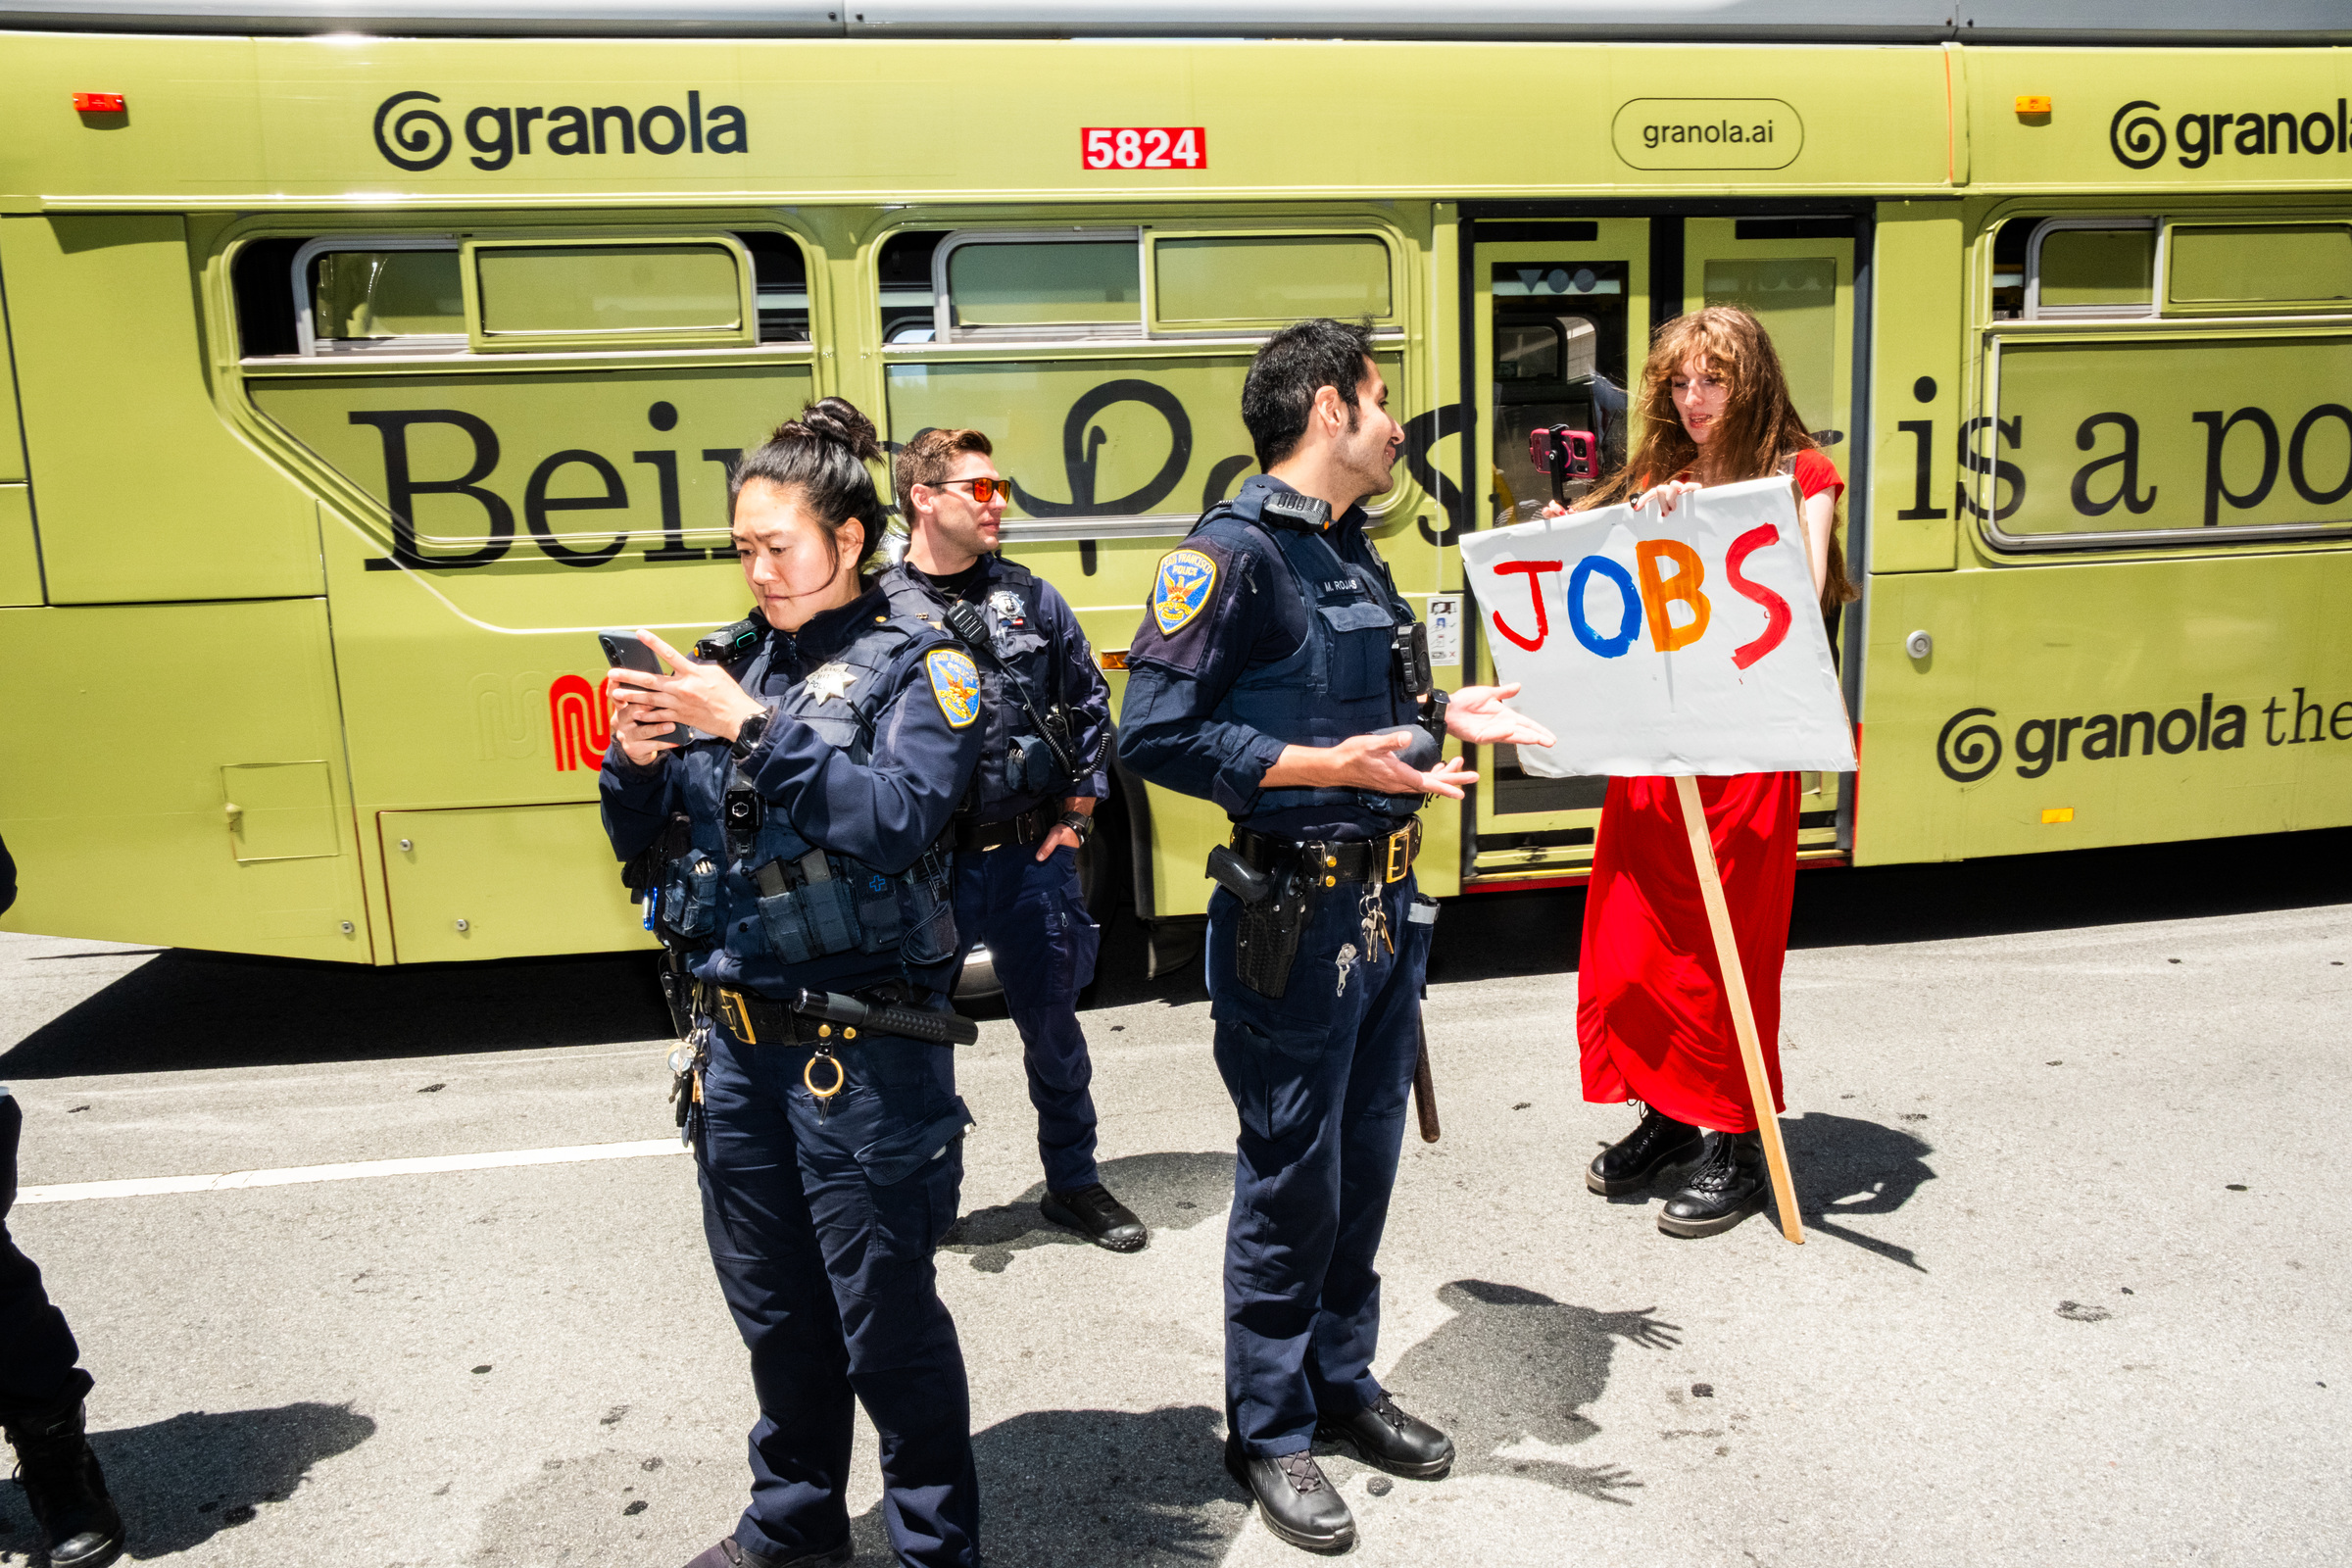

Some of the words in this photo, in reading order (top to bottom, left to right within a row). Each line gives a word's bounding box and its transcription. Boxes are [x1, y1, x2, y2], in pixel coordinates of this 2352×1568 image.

[465, 90, 749, 172] granola
[1087, 129, 1200, 169] 5824
[1643, 119, 1773, 148] granola.ai
[2176, 97, 2352, 170] granol
[348, 400, 938, 571] Bei
[1897, 375, 2027, 521] is
[2071, 412, 2158, 516] a
[2191, 403, 2352, 527] po
[1163, 555, 1177, 567] SAN
[1178, 553, 1214, 575] FRANCISCO
[1172, 564, 1199, 576] POLICE
[1324, 581, 1334, 592] M.
[1334, 579, 1357, 591] ROJAS
[1493, 521, 1792, 670] JOBS
[2015, 692, 2247, 779] granola
[2262, 687, 2352, 747] the
